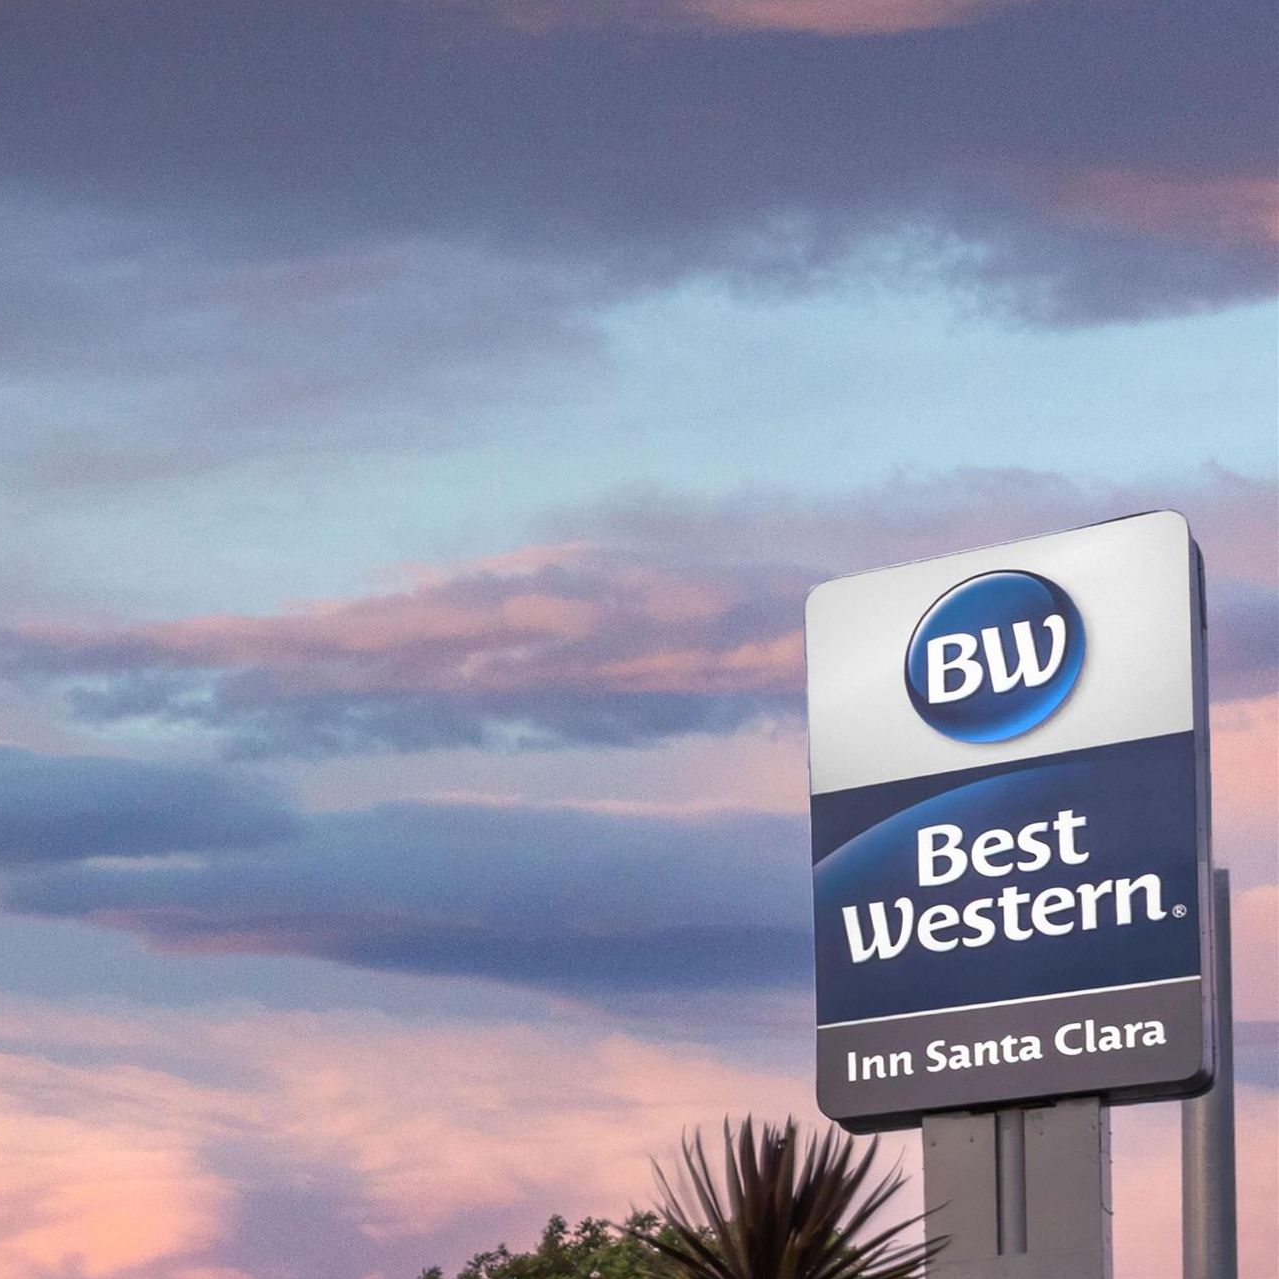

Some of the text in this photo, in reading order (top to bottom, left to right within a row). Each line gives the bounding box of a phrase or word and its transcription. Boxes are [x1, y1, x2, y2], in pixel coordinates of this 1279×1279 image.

[927, 614, 1066, 704] BW
[918, 809, 1089, 887] Best
[847, 1019, 1167, 1082] Inn Santa Clara
